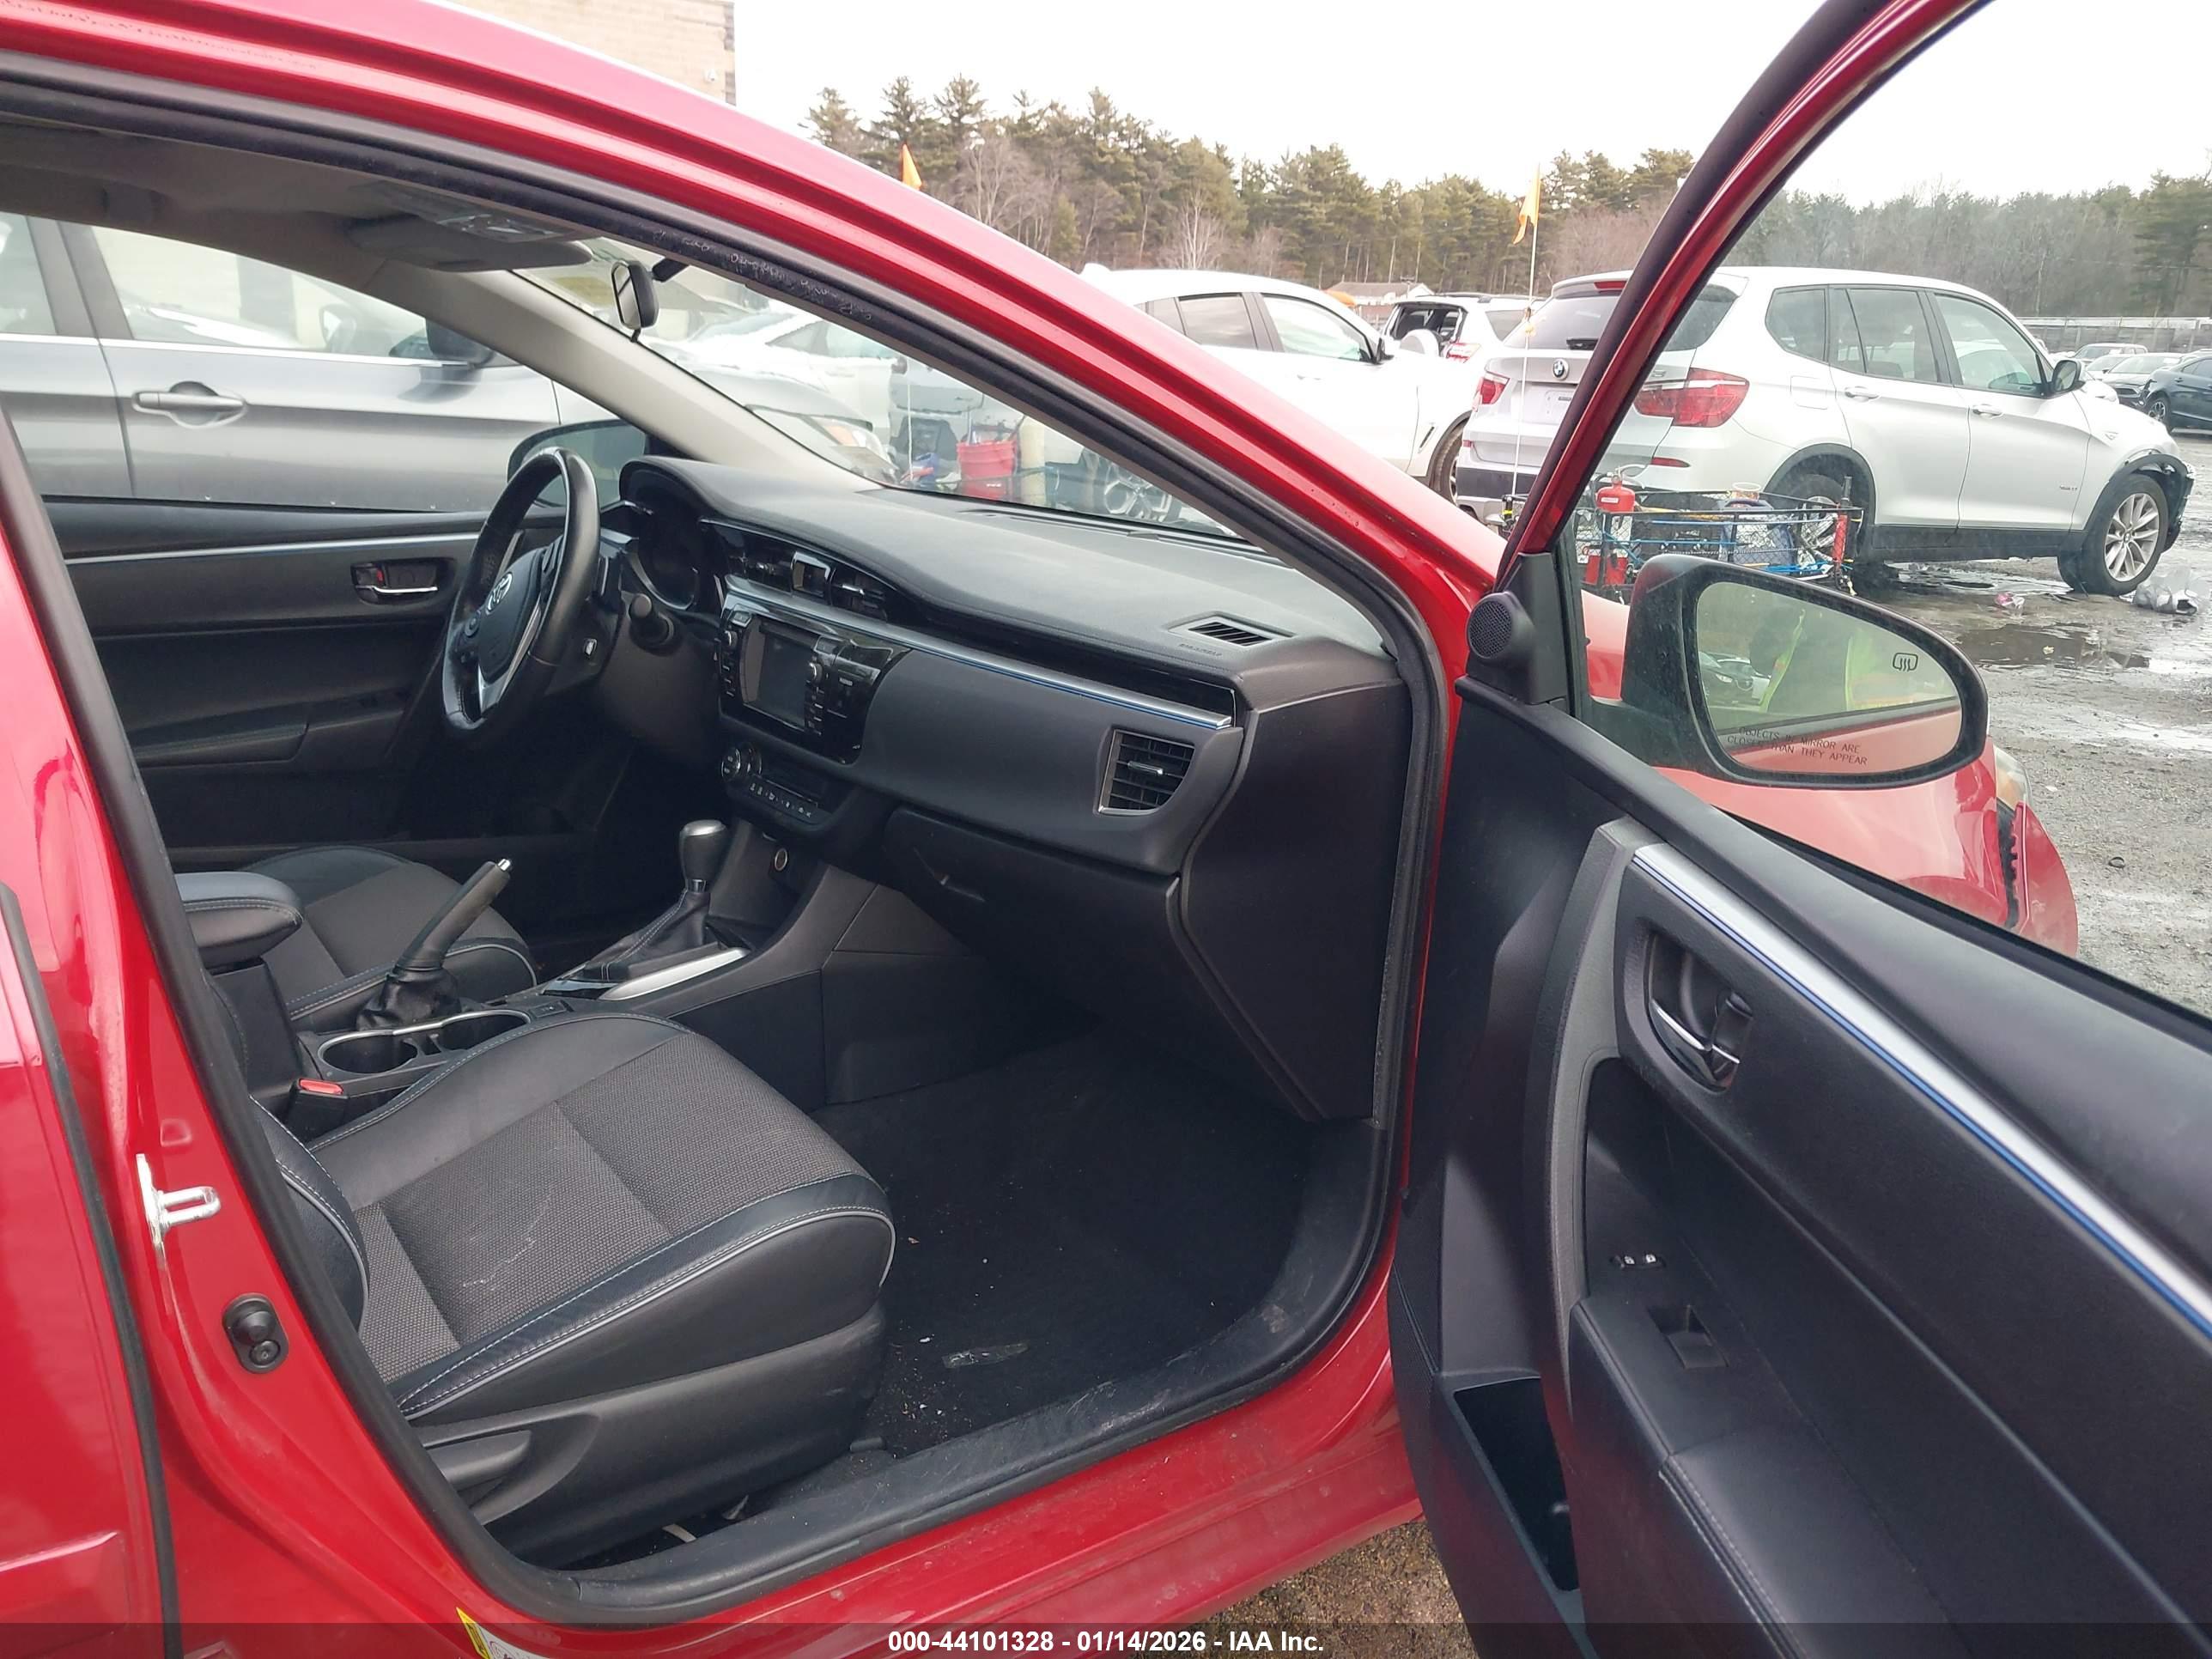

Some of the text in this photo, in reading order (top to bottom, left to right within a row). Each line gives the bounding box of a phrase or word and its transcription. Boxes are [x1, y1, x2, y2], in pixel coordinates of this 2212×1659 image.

[1739, 726, 1861, 754] OBJECTS IN MIRROR ARE
[1802, 747, 1825, 759] THEY
[1829, 752, 1868, 765] APPEAR
